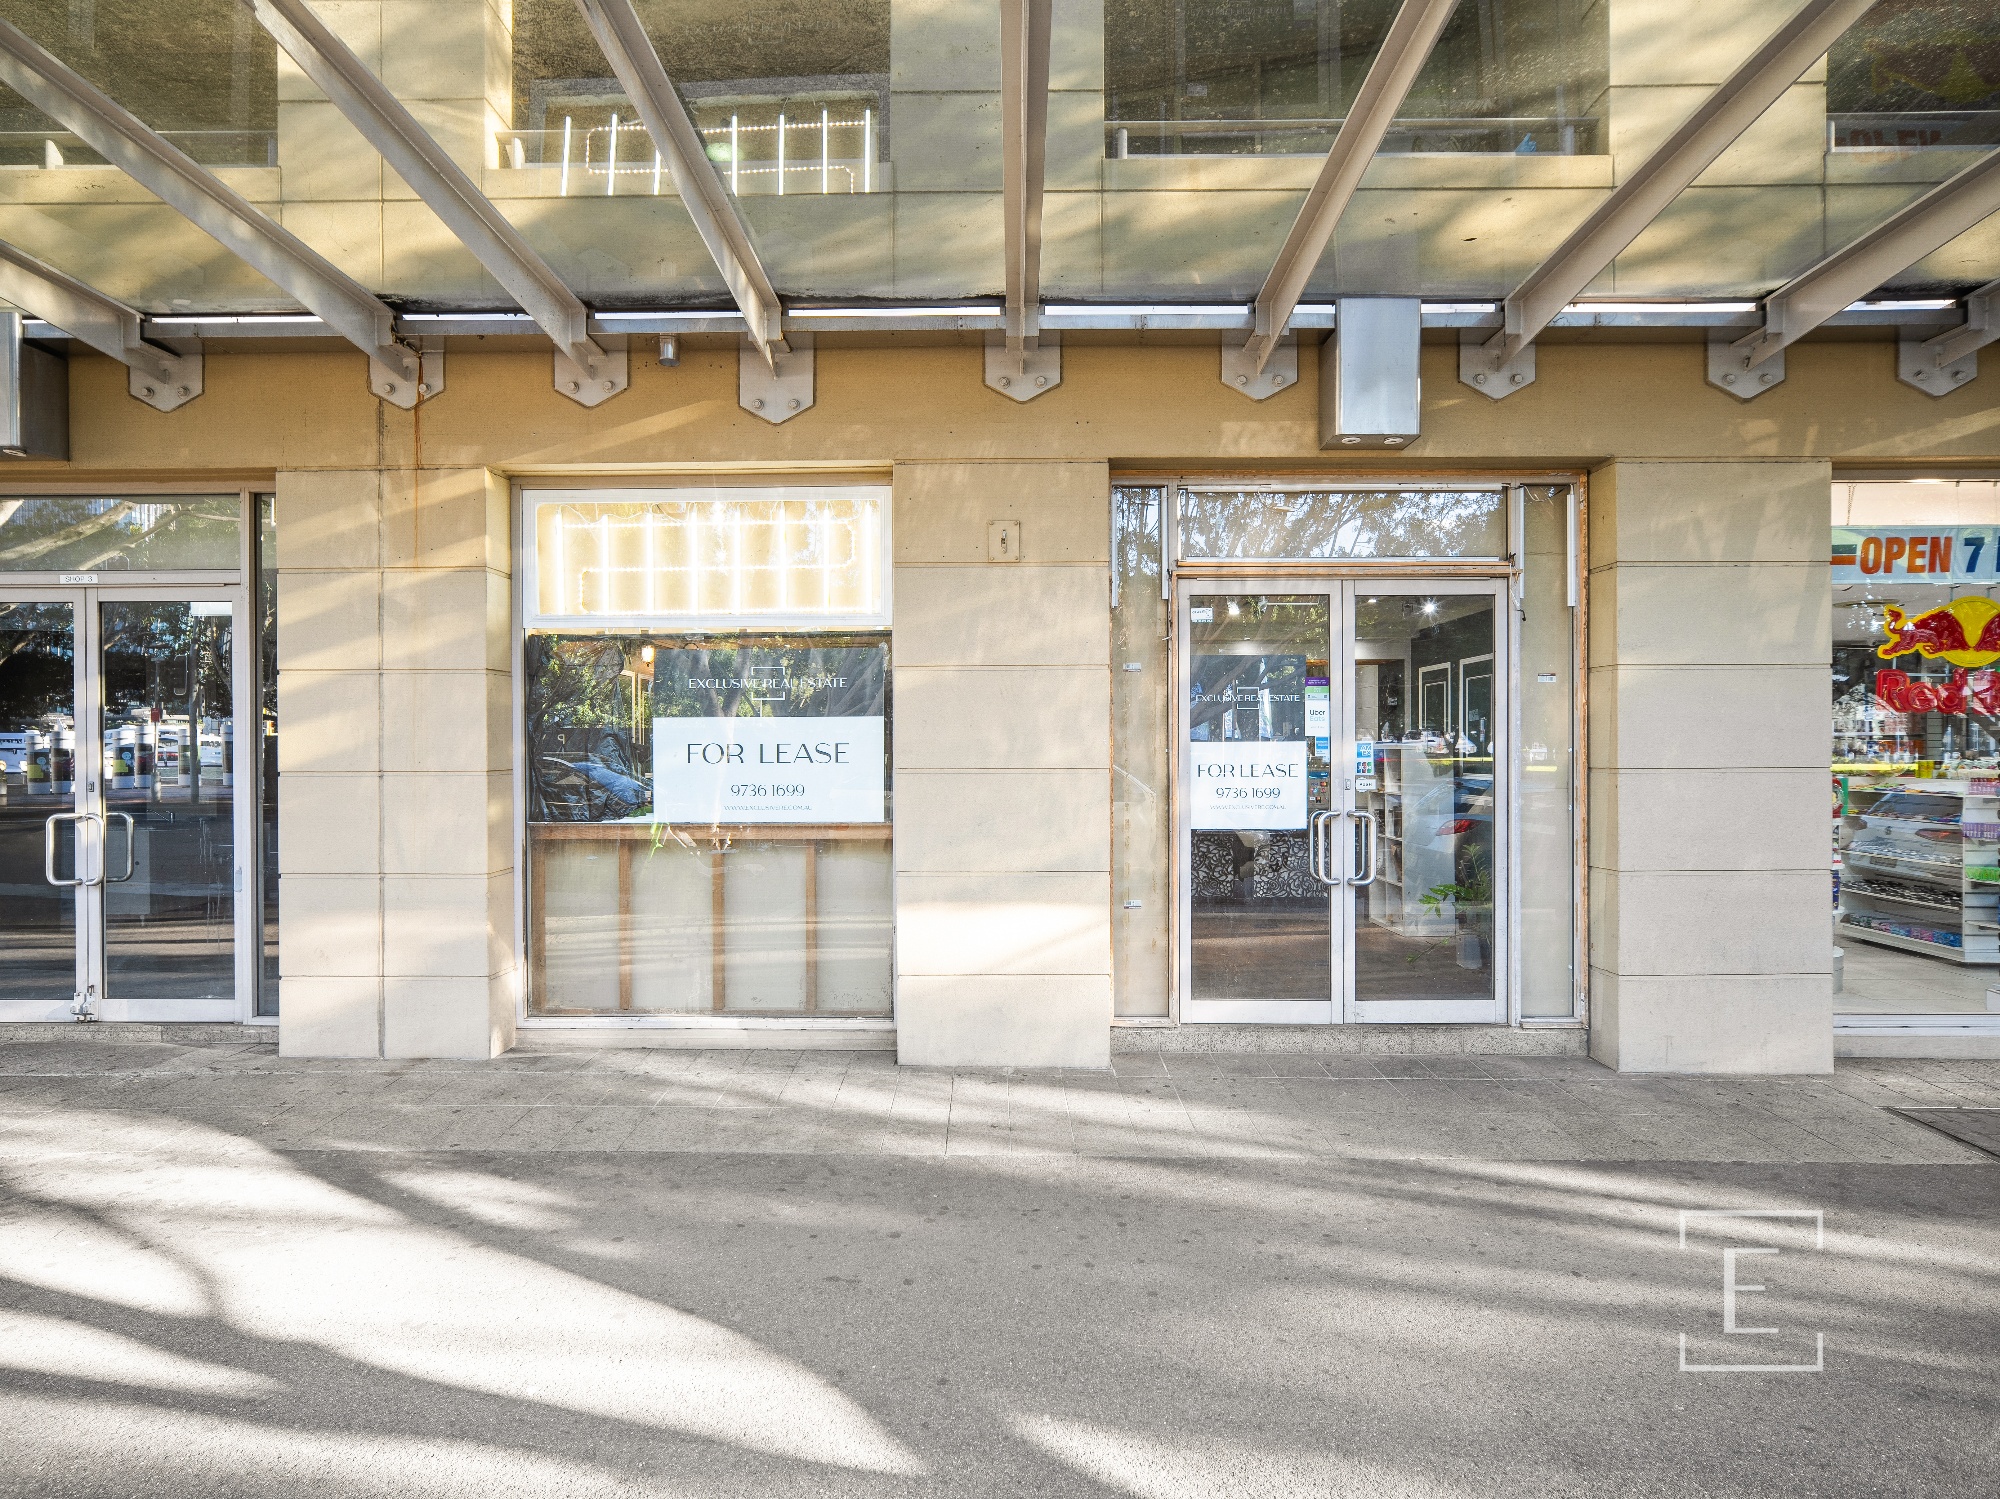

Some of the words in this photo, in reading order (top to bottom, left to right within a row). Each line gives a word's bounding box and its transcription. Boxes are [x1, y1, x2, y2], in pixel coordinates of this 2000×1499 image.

[1860, 536, 1953, 575] OPEN
[1964, 537, 1985, 573] 7
[65, 575, 85, 583] SHOP
[87, 575, 93, 583] 3
[688, 678, 761, 689] EXCLUSIVE
[763, 678, 797, 688] REAL
[799, 677, 848, 688] ESTATE
[1268, 694, 1301, 702] ESTATE
[687, 742, 745, 765] FOR
[759, 742, 850, 764] LEASE
[1197, 763, 1235, 778] FOR
[1240, 763, 1299, 778] LEASE
[730, 783, 767, 797] 9736
[771, 783, 805, 797] 1699
[1215, 787, 1248, 799] 9736
[1251, 787, 1281, 799] 1699
